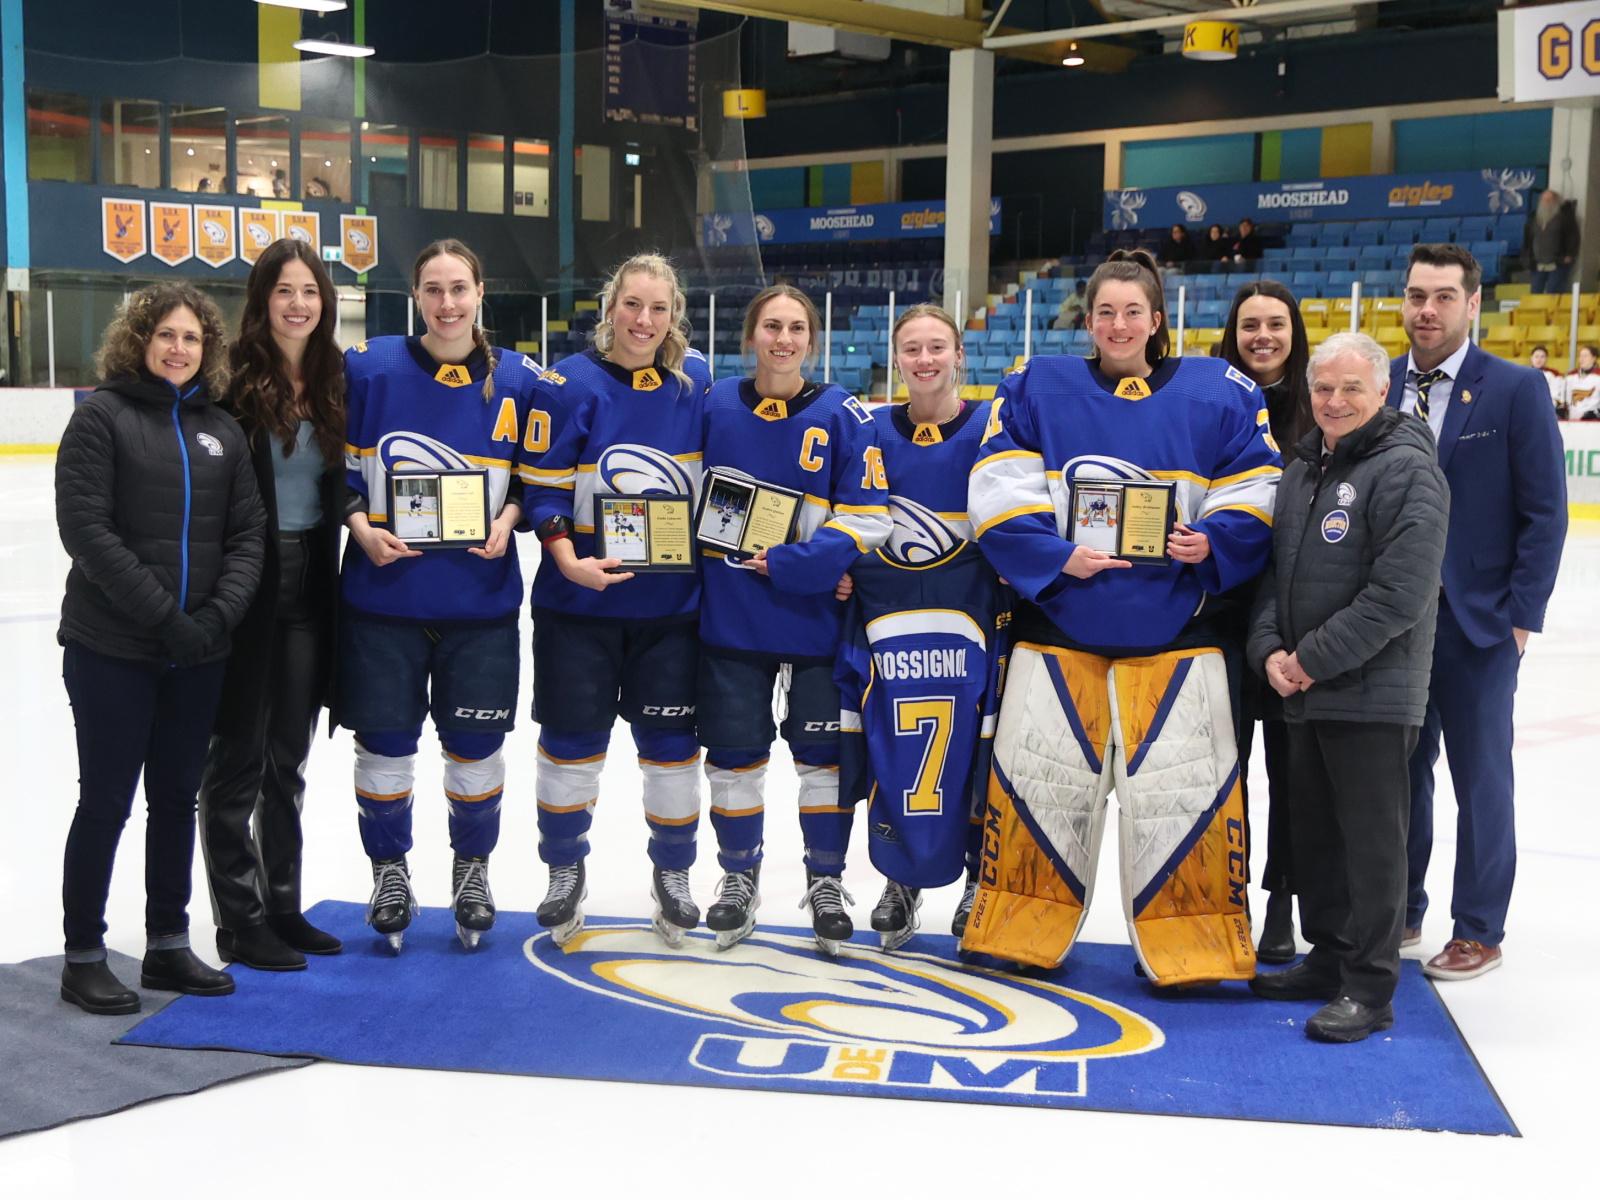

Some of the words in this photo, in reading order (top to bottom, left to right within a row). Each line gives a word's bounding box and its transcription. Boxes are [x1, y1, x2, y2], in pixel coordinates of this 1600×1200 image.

[1221, 28, 1235, 49] K
[738, 94, 750, 111] L
[1257, 189, 1349, 209] MOOSEHEAD
[809, 213, 875, 231] MOOSEHEAD
[492, 397, 519, 443] A
[524, 408, 552, 453] 0
[799, 426, 830, 473] C
[873, 648, 968, 680] ROSSIGNOL
[455, 706, 511, 720] CCM
[642, 704, 696, 717] CCM
[804, 721, 841, 732] CC
[893, 695, 955, 816] 7
[981, 802, 1003, 887] CCM
[1225, 816, 1245, 907] CCM
[831, 1047, 887, 1082] DE
[887, 1050, 1087, 1097] M
